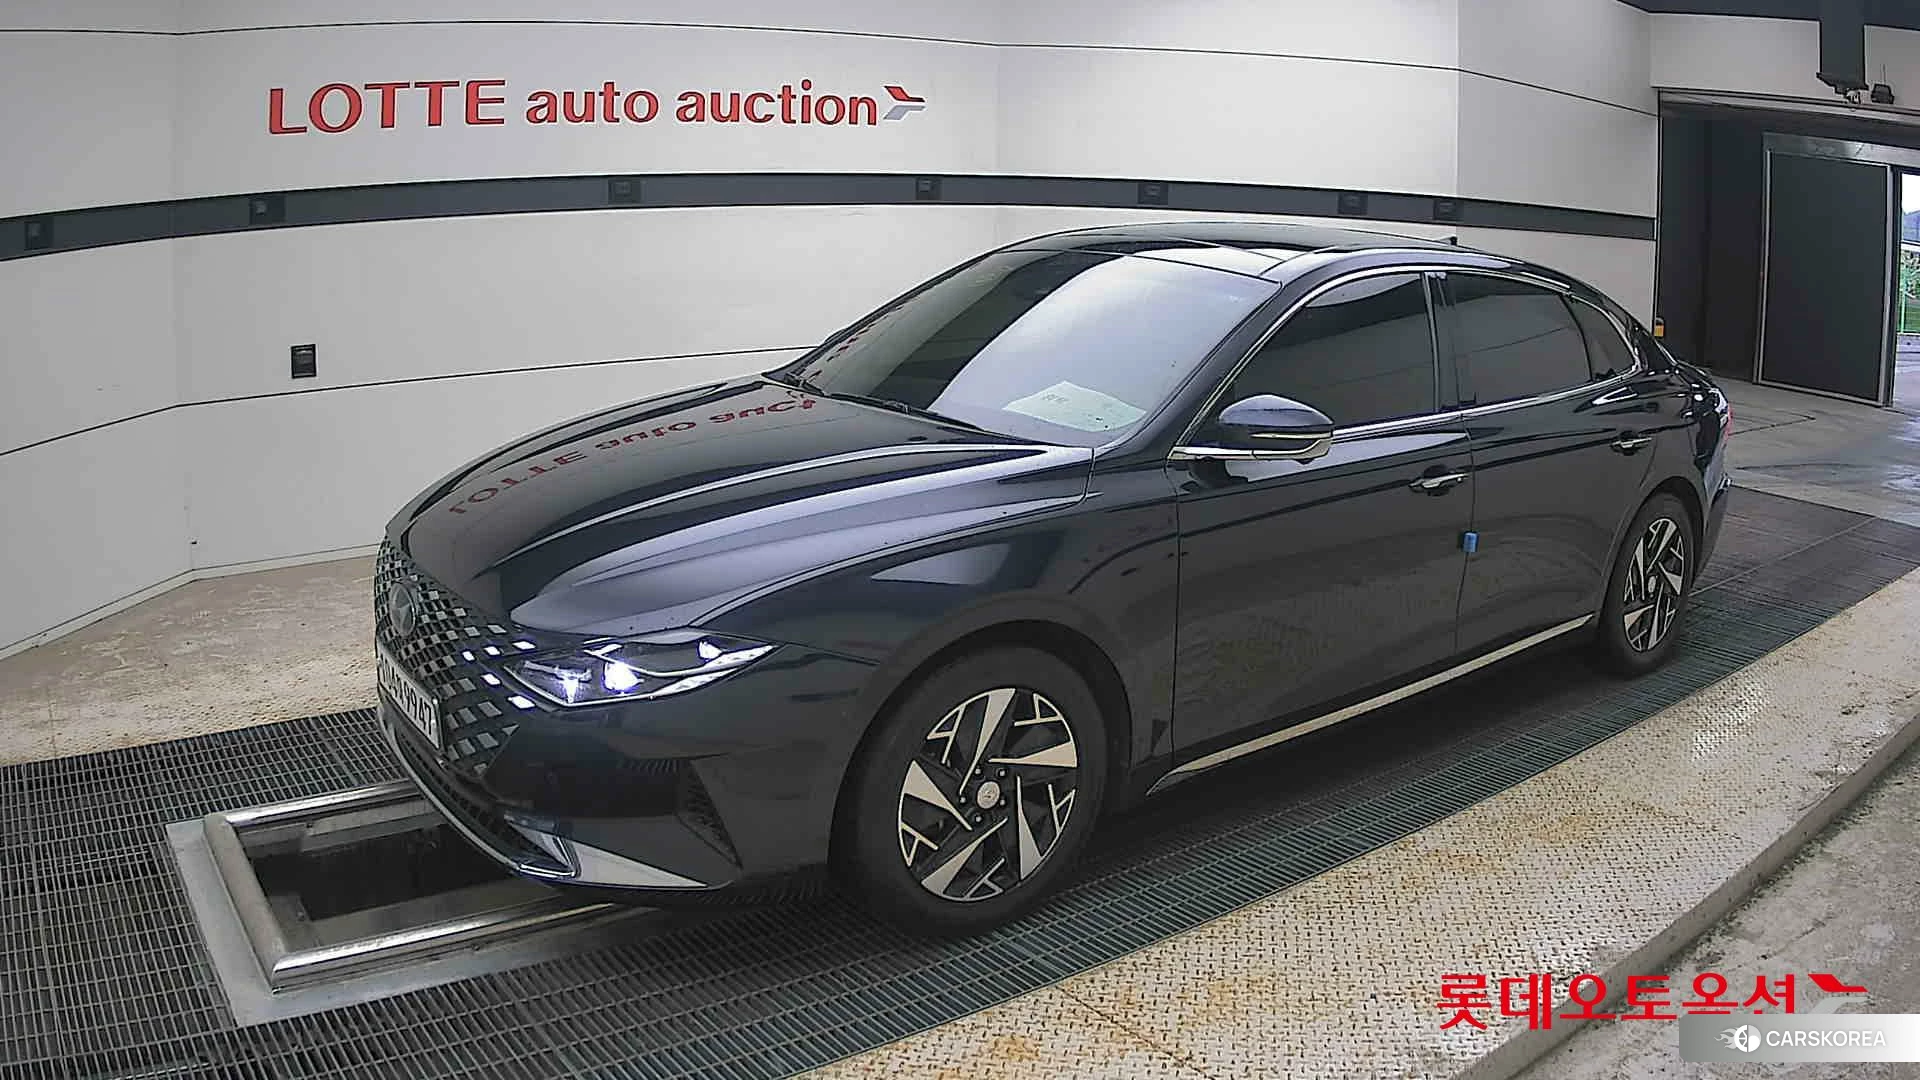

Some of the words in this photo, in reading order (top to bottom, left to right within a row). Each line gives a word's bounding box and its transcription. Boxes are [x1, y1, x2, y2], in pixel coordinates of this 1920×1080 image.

[268, 79, 506, 135] LOTTE
[526, 81, 660, 124] auto
[675, 79, 878, 126] auction
